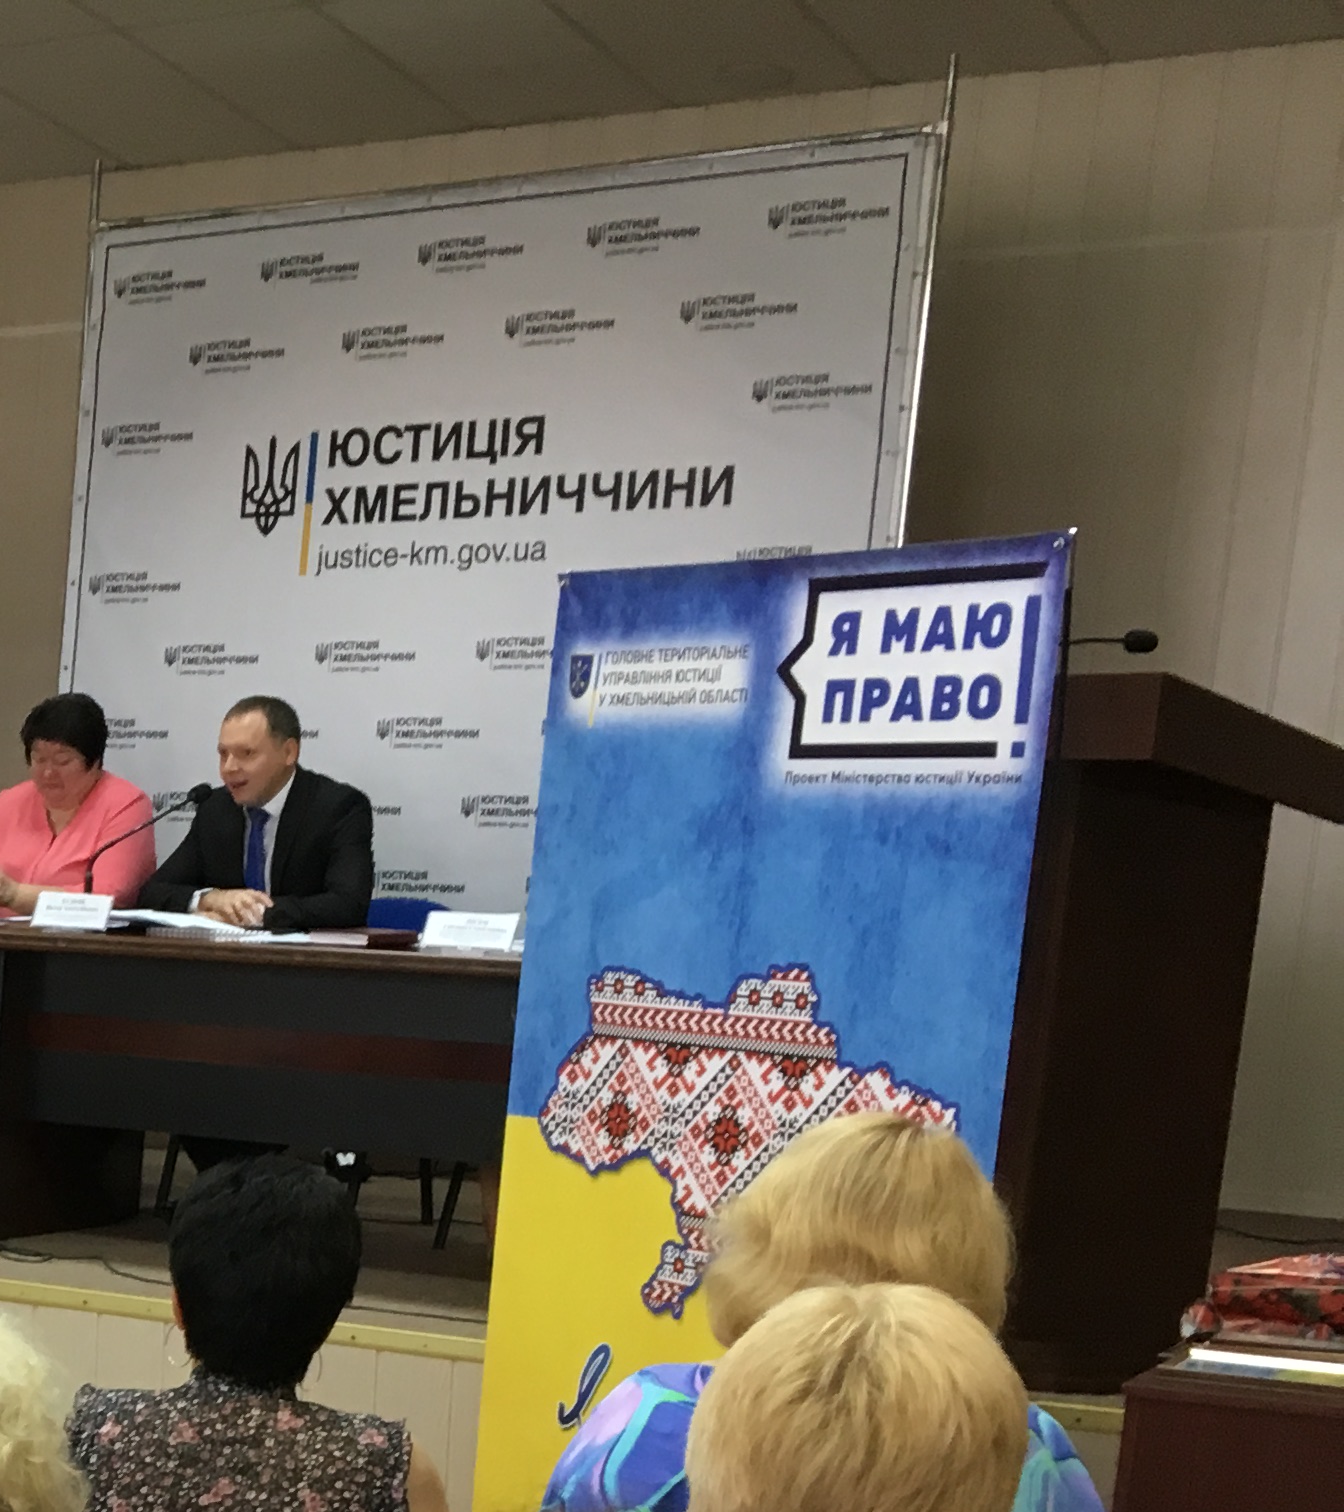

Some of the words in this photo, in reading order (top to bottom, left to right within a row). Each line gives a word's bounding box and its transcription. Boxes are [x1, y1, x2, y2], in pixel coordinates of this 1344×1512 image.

[327, 415, 547, 469] ЮСТИЦІЯ
[322, 464, 735, 526] ХМЕЛЬНИЧЧИНИ
[315, 539, 548, 576] justice-km.gov.ua
[828, 610, 862, 658] Я
[880, 601, 1014, 654] МАЮ
[605, 650, 655, 666] ГОЛОВНЕ
[658, 644, 750, 663] ТЕРИТОРІАЛЬНЕ
[602, 668, 672, 686] УПРАВЛІННЯ
[599, 692, 607, 707] У
[609, 687, 697, 707] ХМЕЛЬНИЦЬКІЙ
[699, 688, 749, 705] ОБЛАСТІ
[784, 770, 828, 786] Проект
[966, 768, 1023, 787] України
